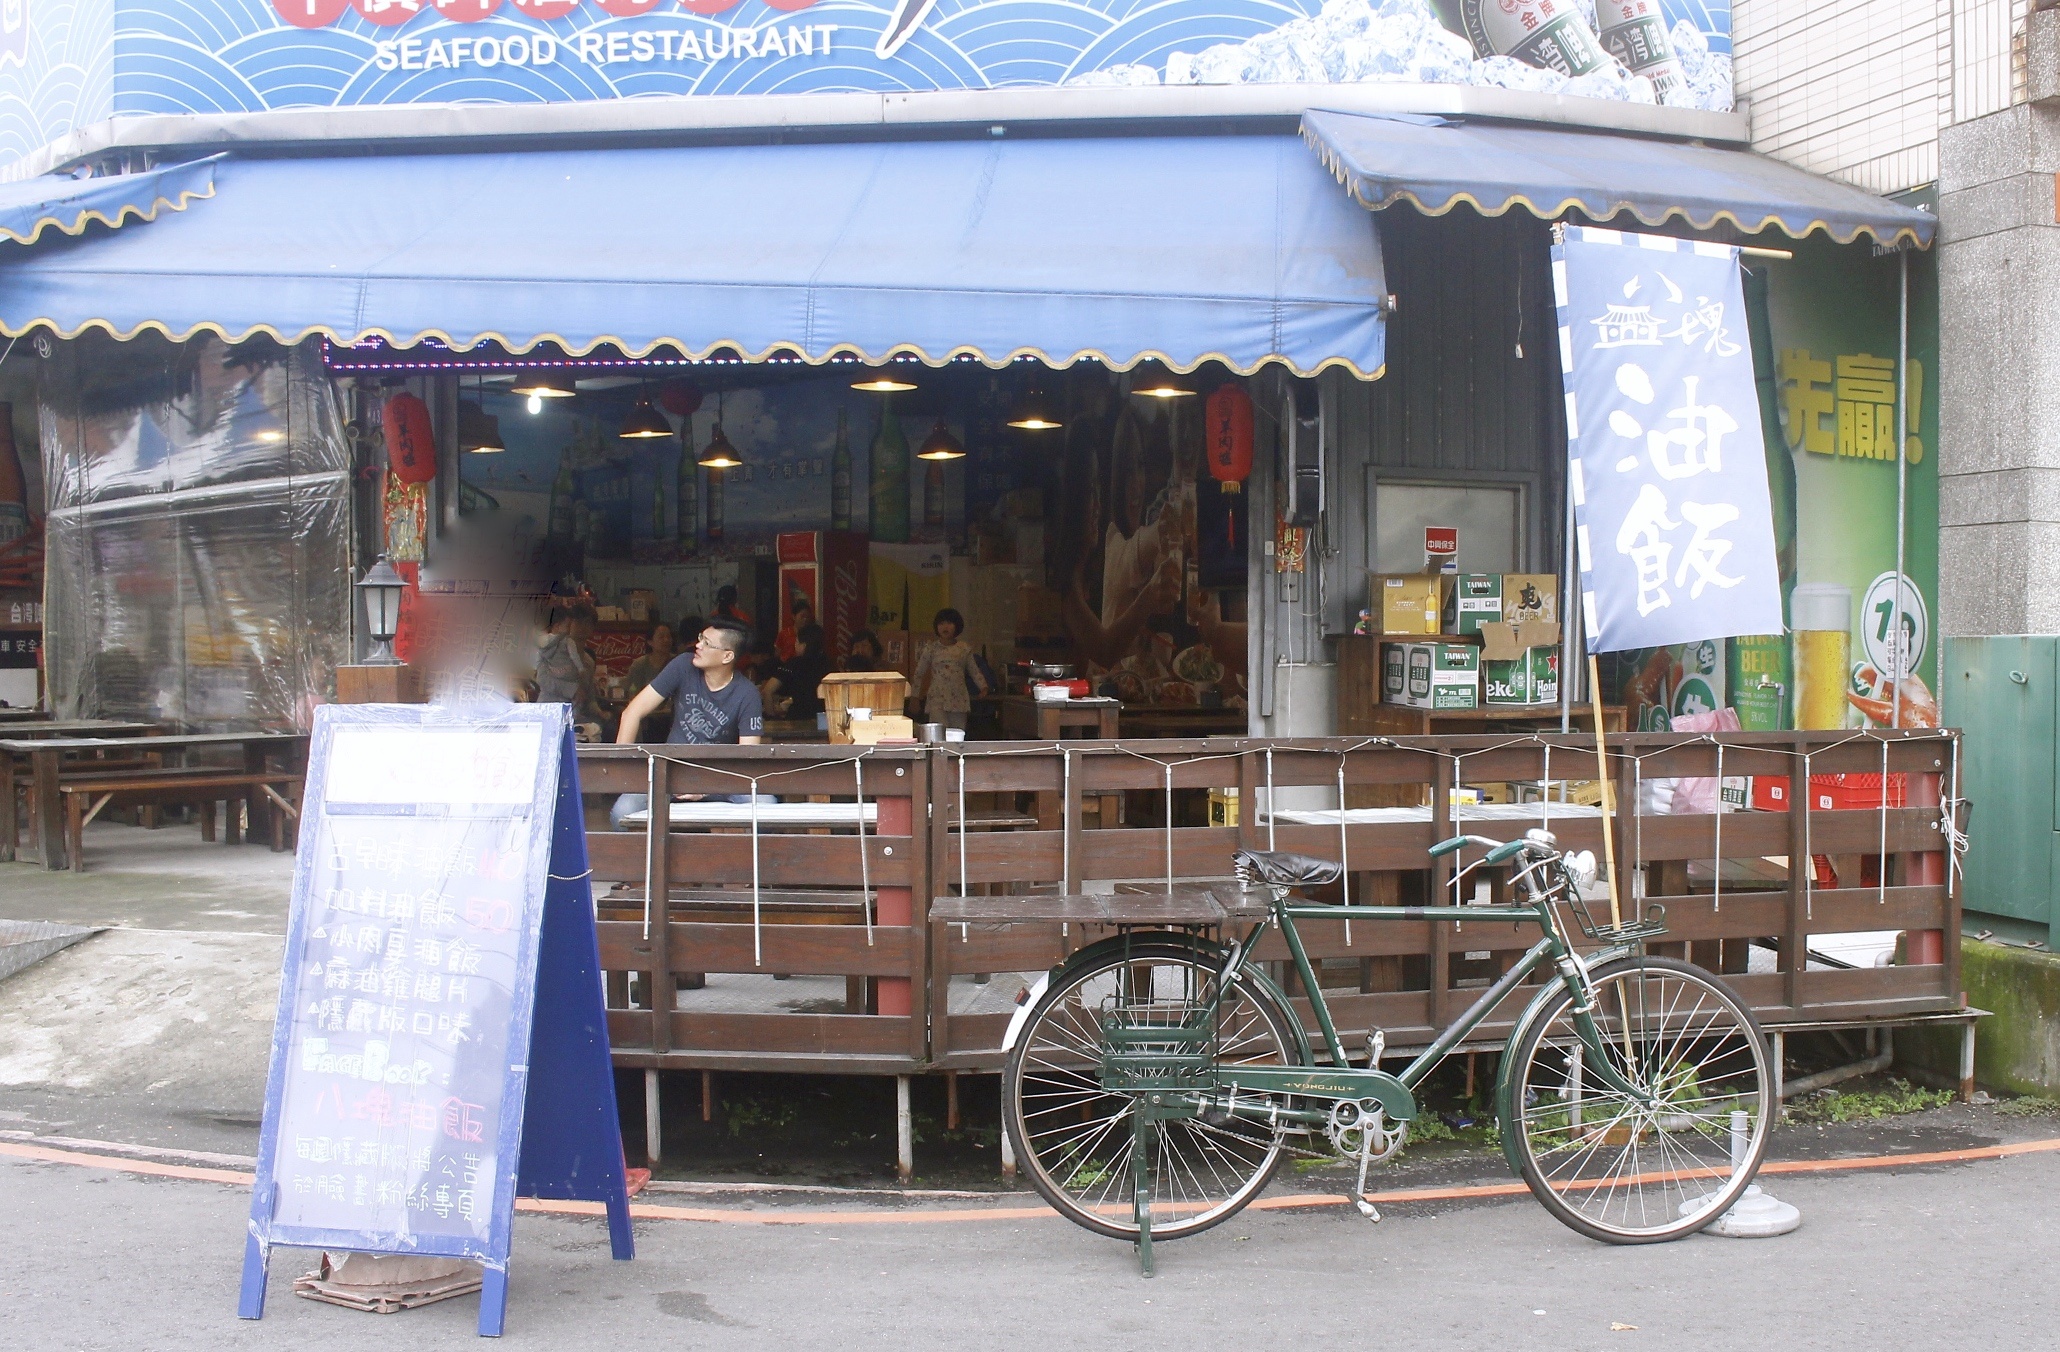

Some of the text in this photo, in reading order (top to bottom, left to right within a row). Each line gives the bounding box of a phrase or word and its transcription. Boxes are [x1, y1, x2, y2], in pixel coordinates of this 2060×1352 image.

[375, 24, 839, 71] SEAFOOD RESTAURANT
[1466, 581, 1492, 589] TAIWAN
[870, 605, 897, 626] Bar
[1520, 612, 1538, 621] BEER
[1741, 650, 1780, 673] BEER
[465, 897, 514, 933] 50
[1293, 1082, 1346, 1091] YONGJIU
